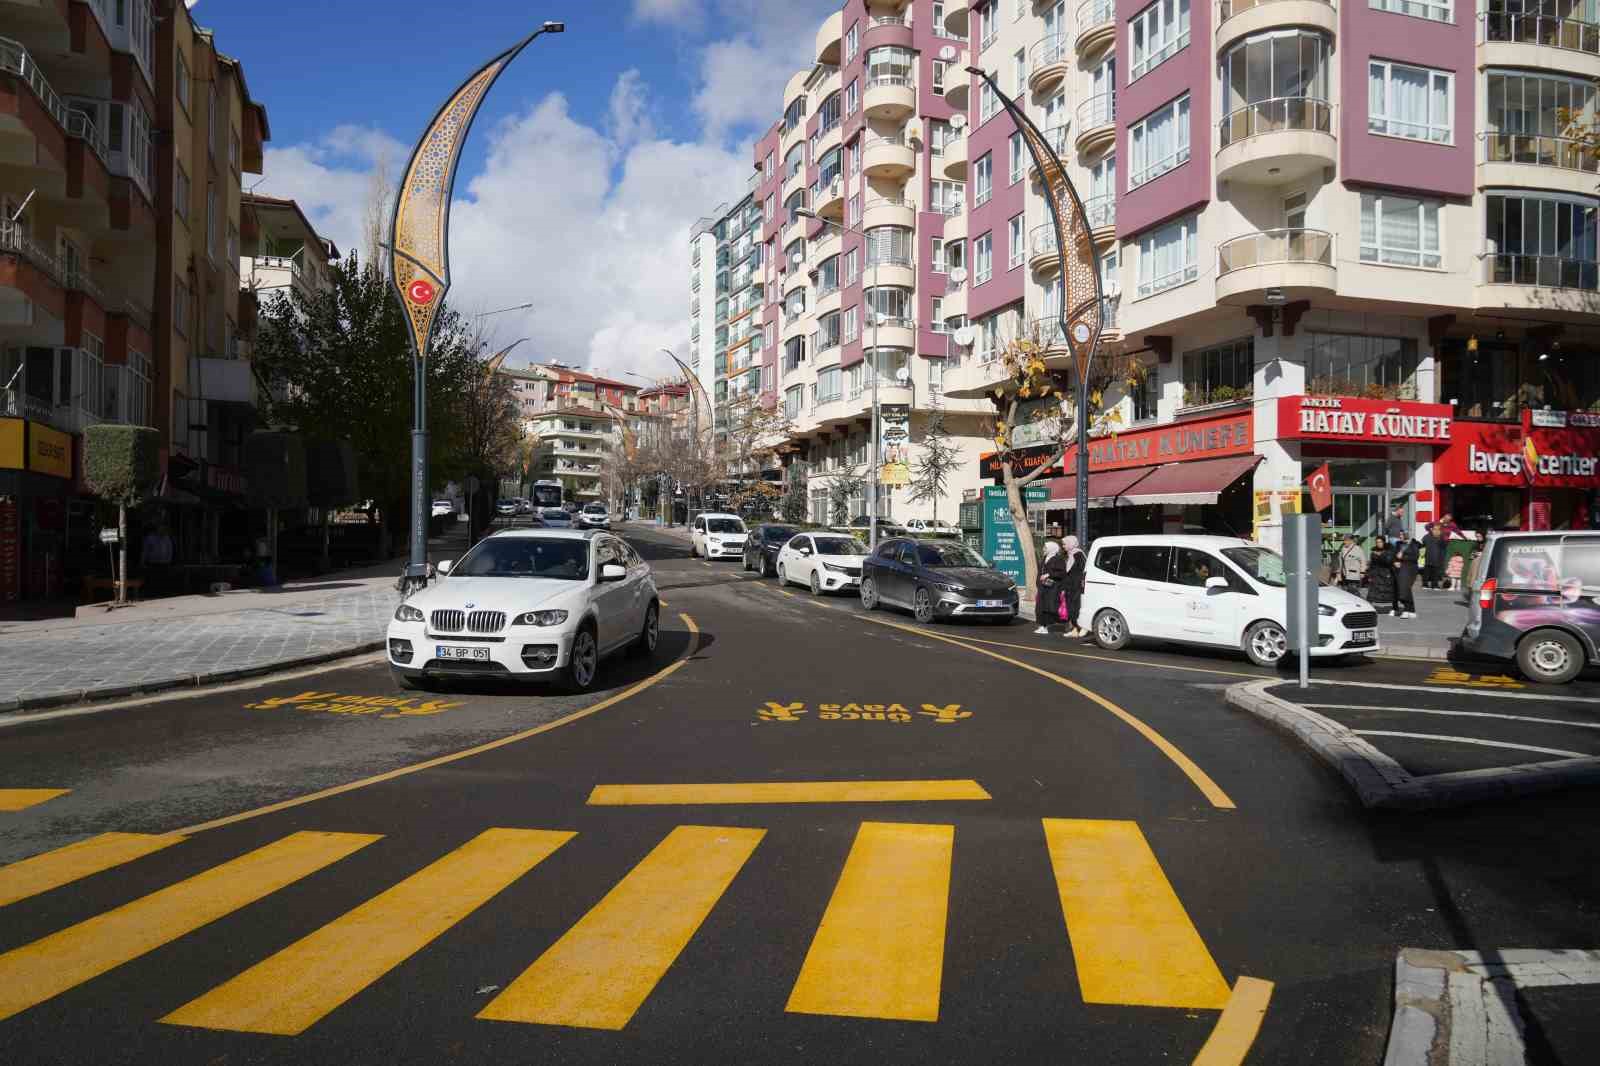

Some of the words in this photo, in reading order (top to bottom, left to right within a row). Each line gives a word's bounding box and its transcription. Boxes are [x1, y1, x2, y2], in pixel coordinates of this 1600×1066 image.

[1299, 410, 1366, 434] HATAY
[1371, 408, 1451, 438] KÜNEFE
[1092, 434, 1150, 464] HATAY
[1159, 422, 1249, 455] KÜNEFE
[1469, 443, 1521, 476] lavaş
[1539, 453, 1597, 475] center
